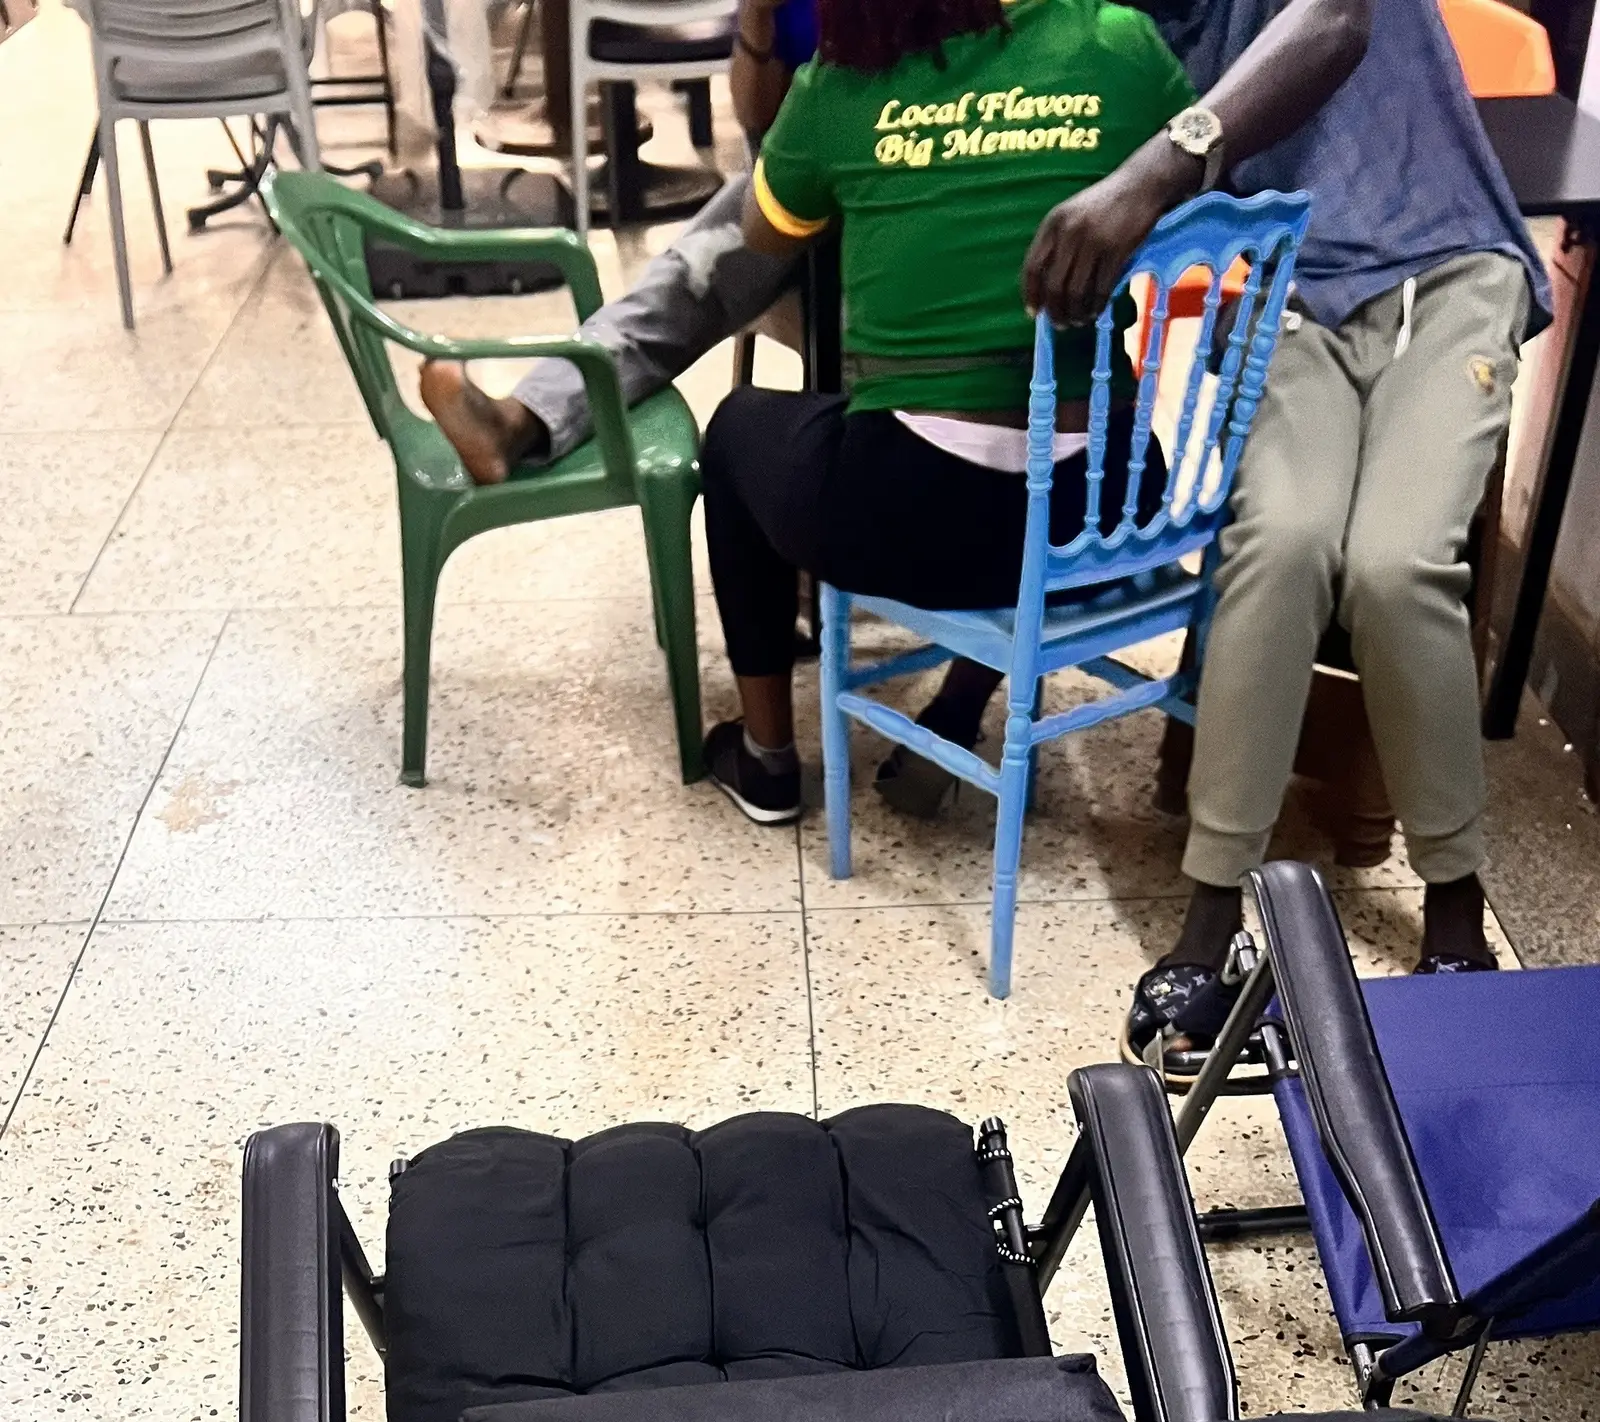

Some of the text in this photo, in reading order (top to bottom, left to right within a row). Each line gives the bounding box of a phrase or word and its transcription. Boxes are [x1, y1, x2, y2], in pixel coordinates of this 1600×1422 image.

[873, 86, 1101, 130] Local Flavors
[875, 119, 1102, 167] Big Memories
